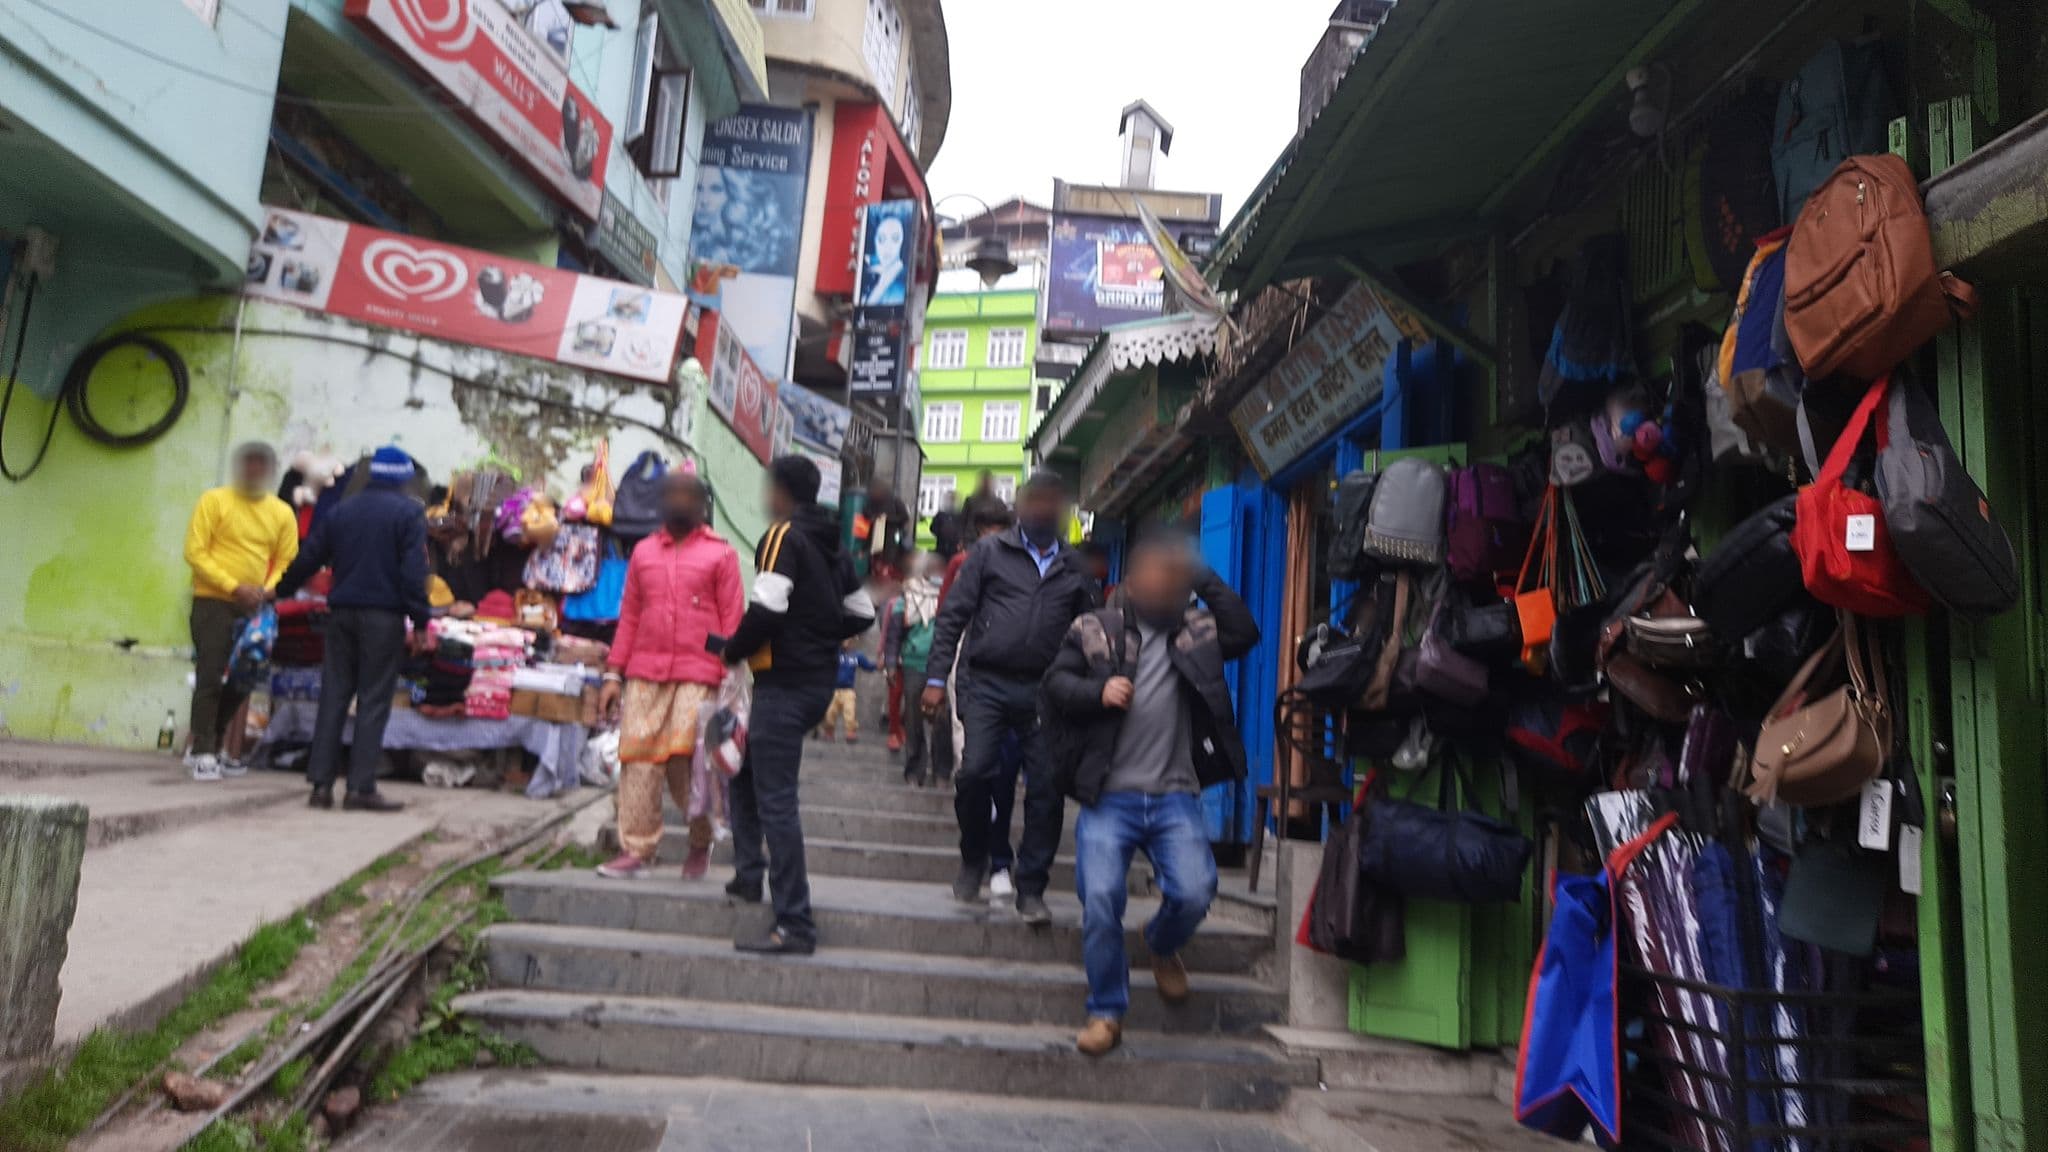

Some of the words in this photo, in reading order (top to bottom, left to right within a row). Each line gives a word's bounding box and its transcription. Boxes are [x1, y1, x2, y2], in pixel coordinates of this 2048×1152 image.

[715, 116, 759, 140] UNISEX
[761, 118, 803, 144] SALON
[731, 144, 789, 172] Service
